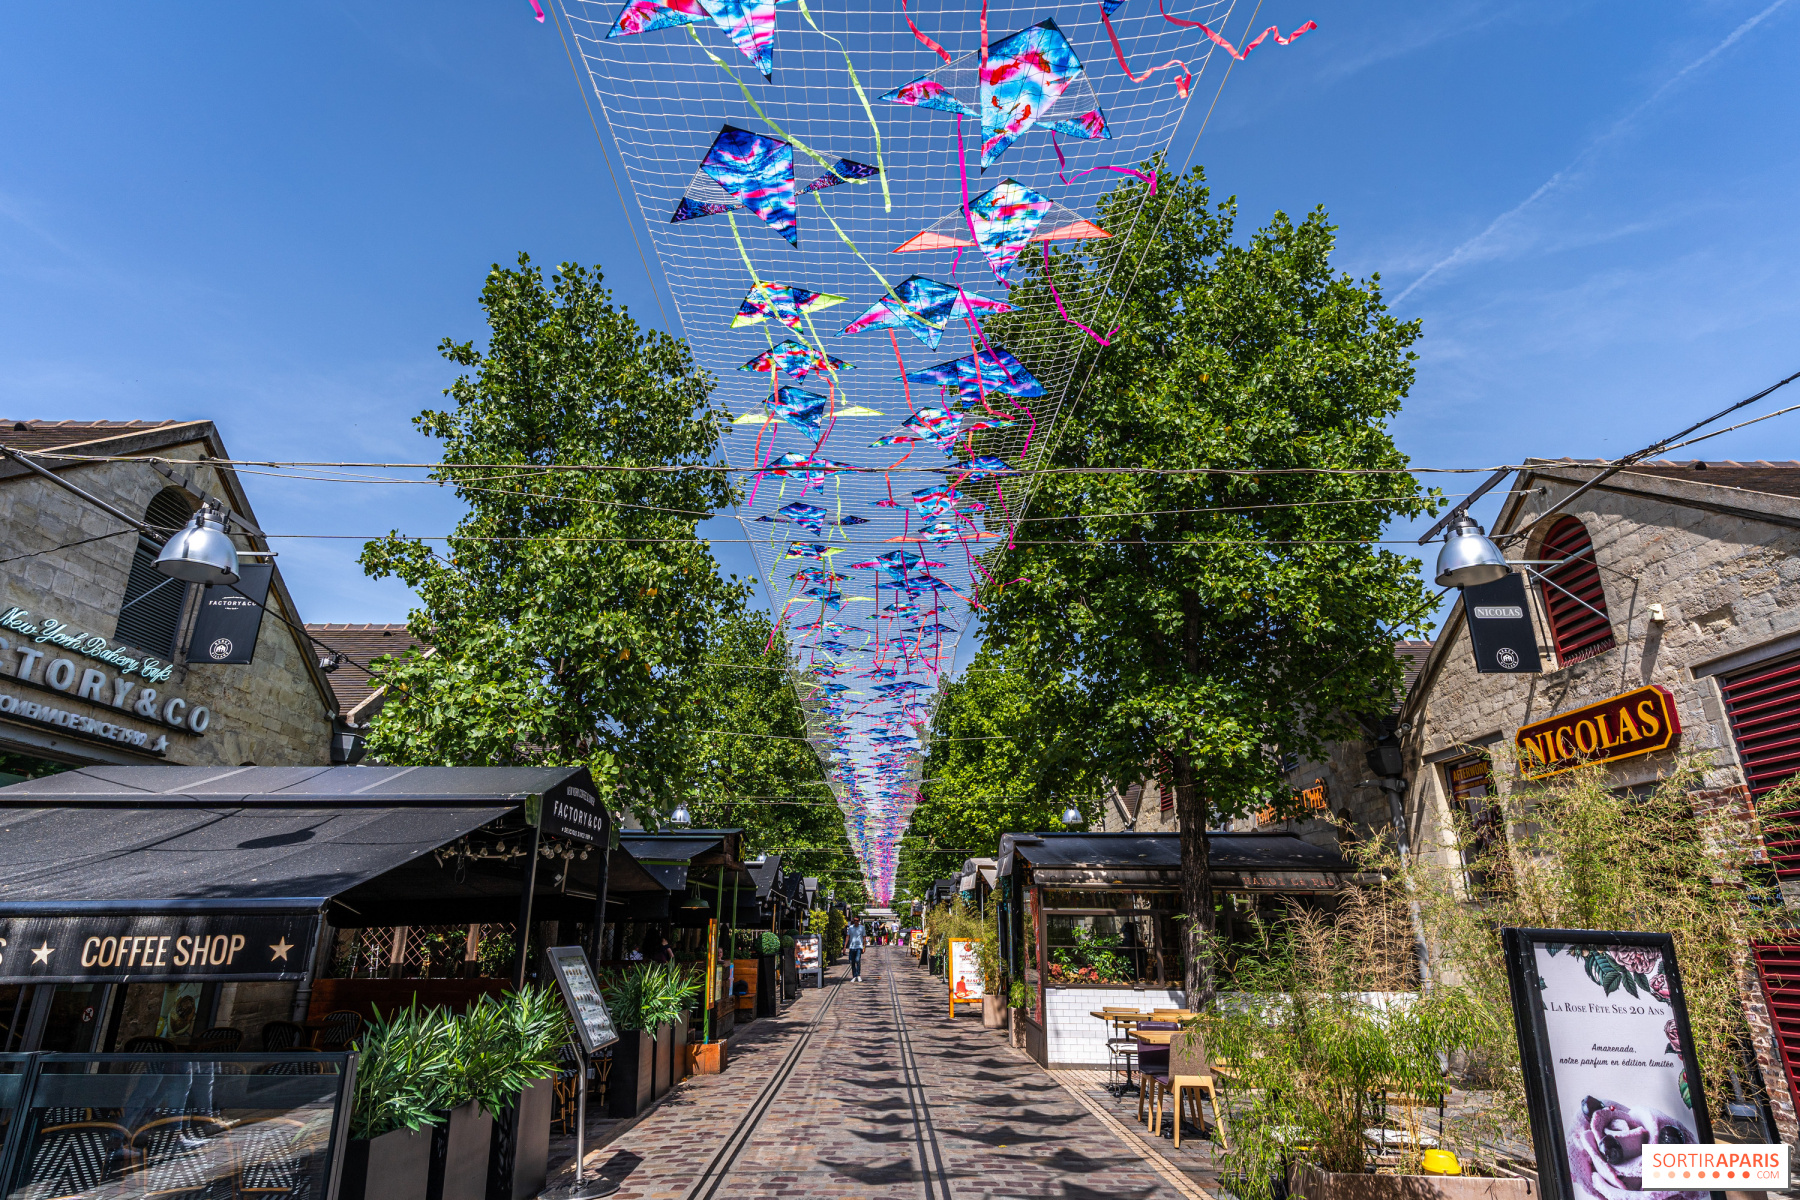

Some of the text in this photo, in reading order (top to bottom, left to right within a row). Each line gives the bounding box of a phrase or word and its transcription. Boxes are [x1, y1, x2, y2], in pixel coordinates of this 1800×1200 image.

[1477, 608, 1521, 617] NICOLAS
[36, 619, 88, 649] York
[82, 637, 139, 674] Bakery
[1522, 700, 1661, 769] NICOLAS
[1242, 877, 1286, 886] HANOI
[80, 934, 245, 967] COFFEE SHOP
[1630, 1006, 1645, 1015] 20
[1592, 1043, 1637, 1054] Amarenada,
[1559, 1057, 1579, 1065] notre
[1580, 1057, 1608, 1069] parfum
[1622, 1058, 1647, 1067] édition
[1649, 1059, 1675, 1068] limitée
